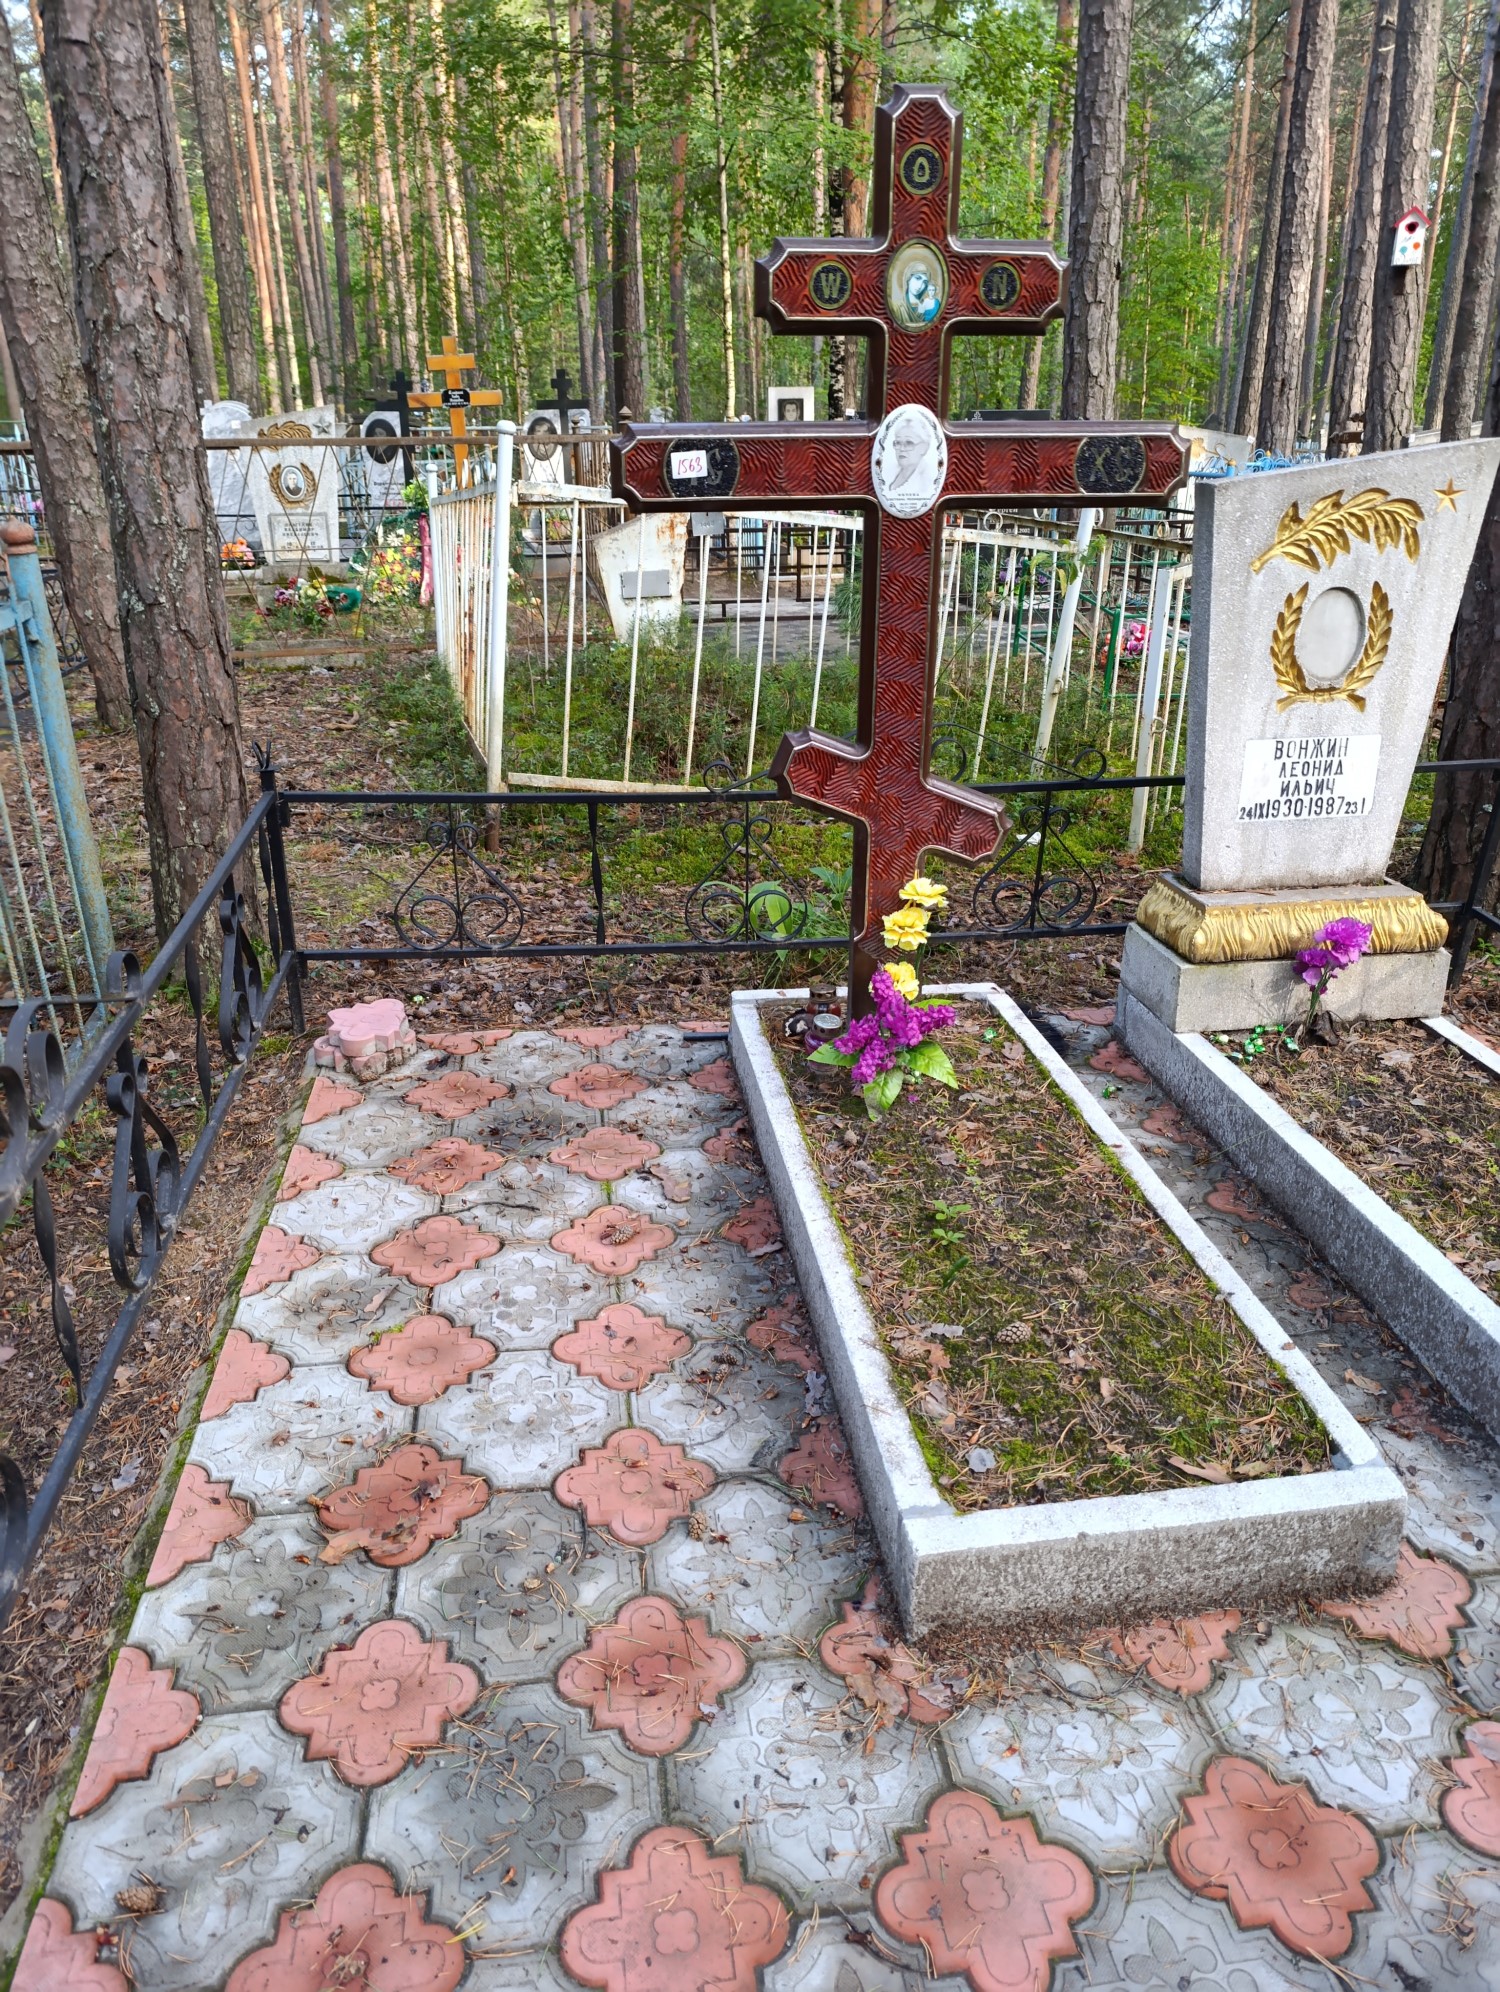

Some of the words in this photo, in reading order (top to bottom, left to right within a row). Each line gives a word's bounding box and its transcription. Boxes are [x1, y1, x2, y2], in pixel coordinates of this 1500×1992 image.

[677, 456, 703, 476] 1563
[1274, 738, 1349, 760] ВОНЖИН
[1279, 759, 1343, 778] ЛЕОНИД
[1280, 778, 1335, 797] ИЛЬИЧ
